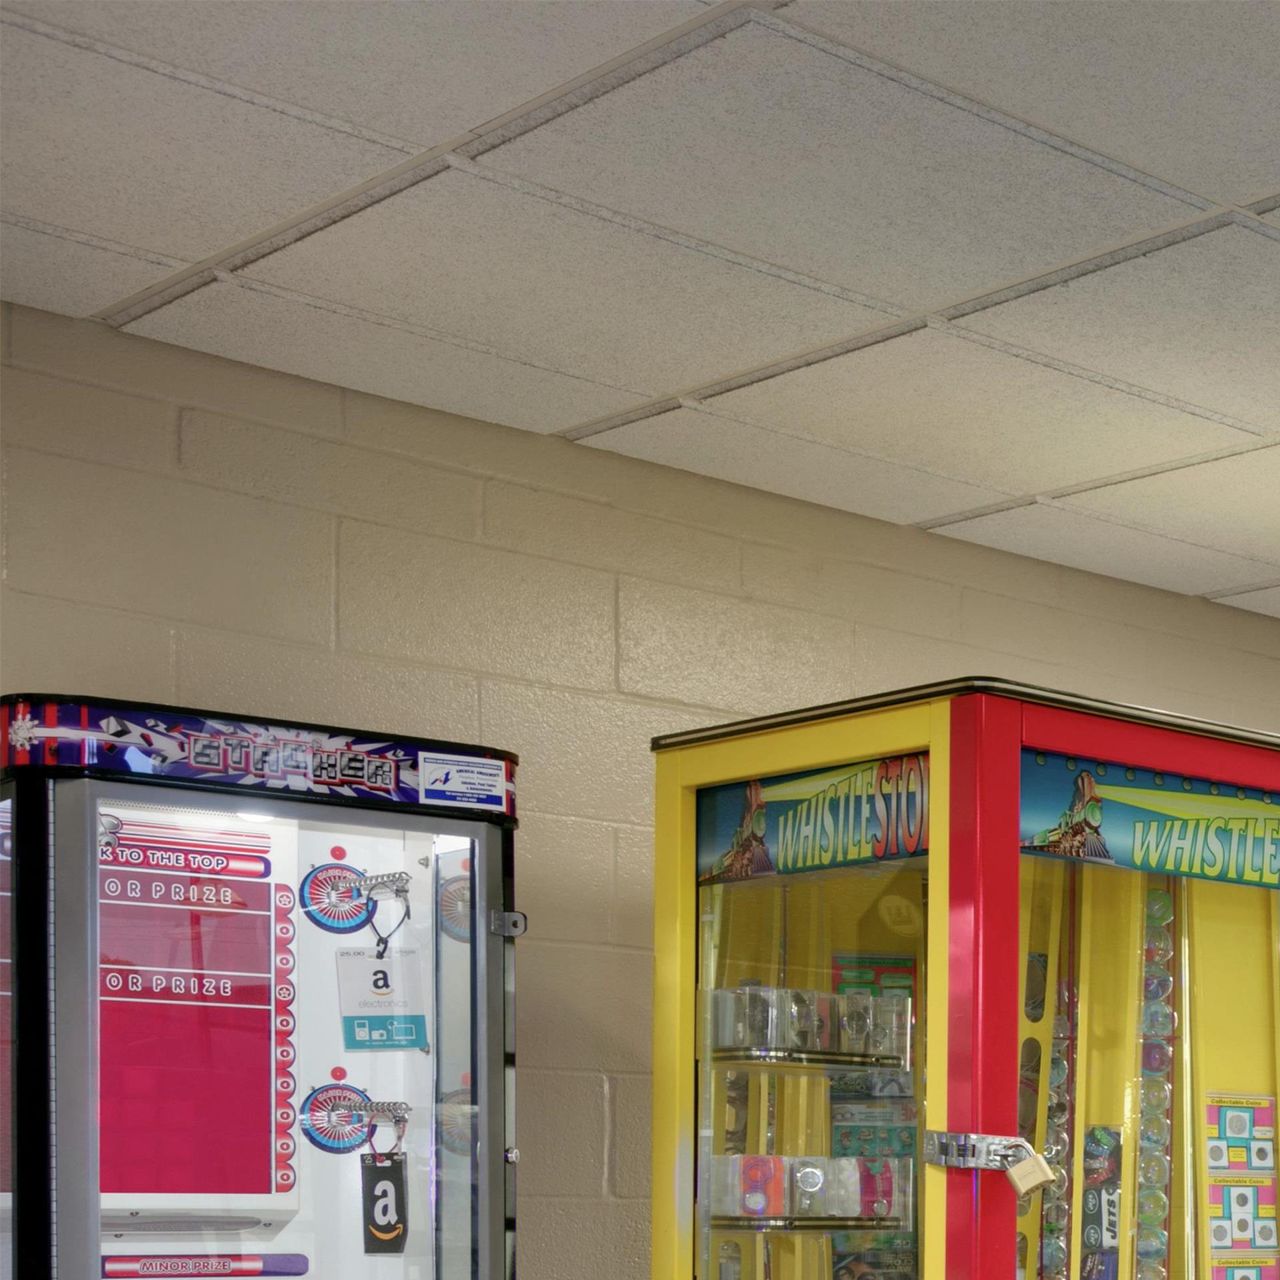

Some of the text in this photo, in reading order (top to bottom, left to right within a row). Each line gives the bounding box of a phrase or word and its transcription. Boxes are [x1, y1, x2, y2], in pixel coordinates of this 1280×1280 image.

[190, 736, 396, 788] STACKER
[118, 848, 143, 863] TO
[148, 851, 185, 866] THE
[189, 855, 227, 870] TOP
[105, 879, 232, 904] OR PRIZE
[106, 973, 232, 996] OR PRIZE
[358, 999, 409, 1010] electronics
[1106, 1199, 1117, 1240] JETS
[140, 1259, 231, 1274] MINOR PRIZE
